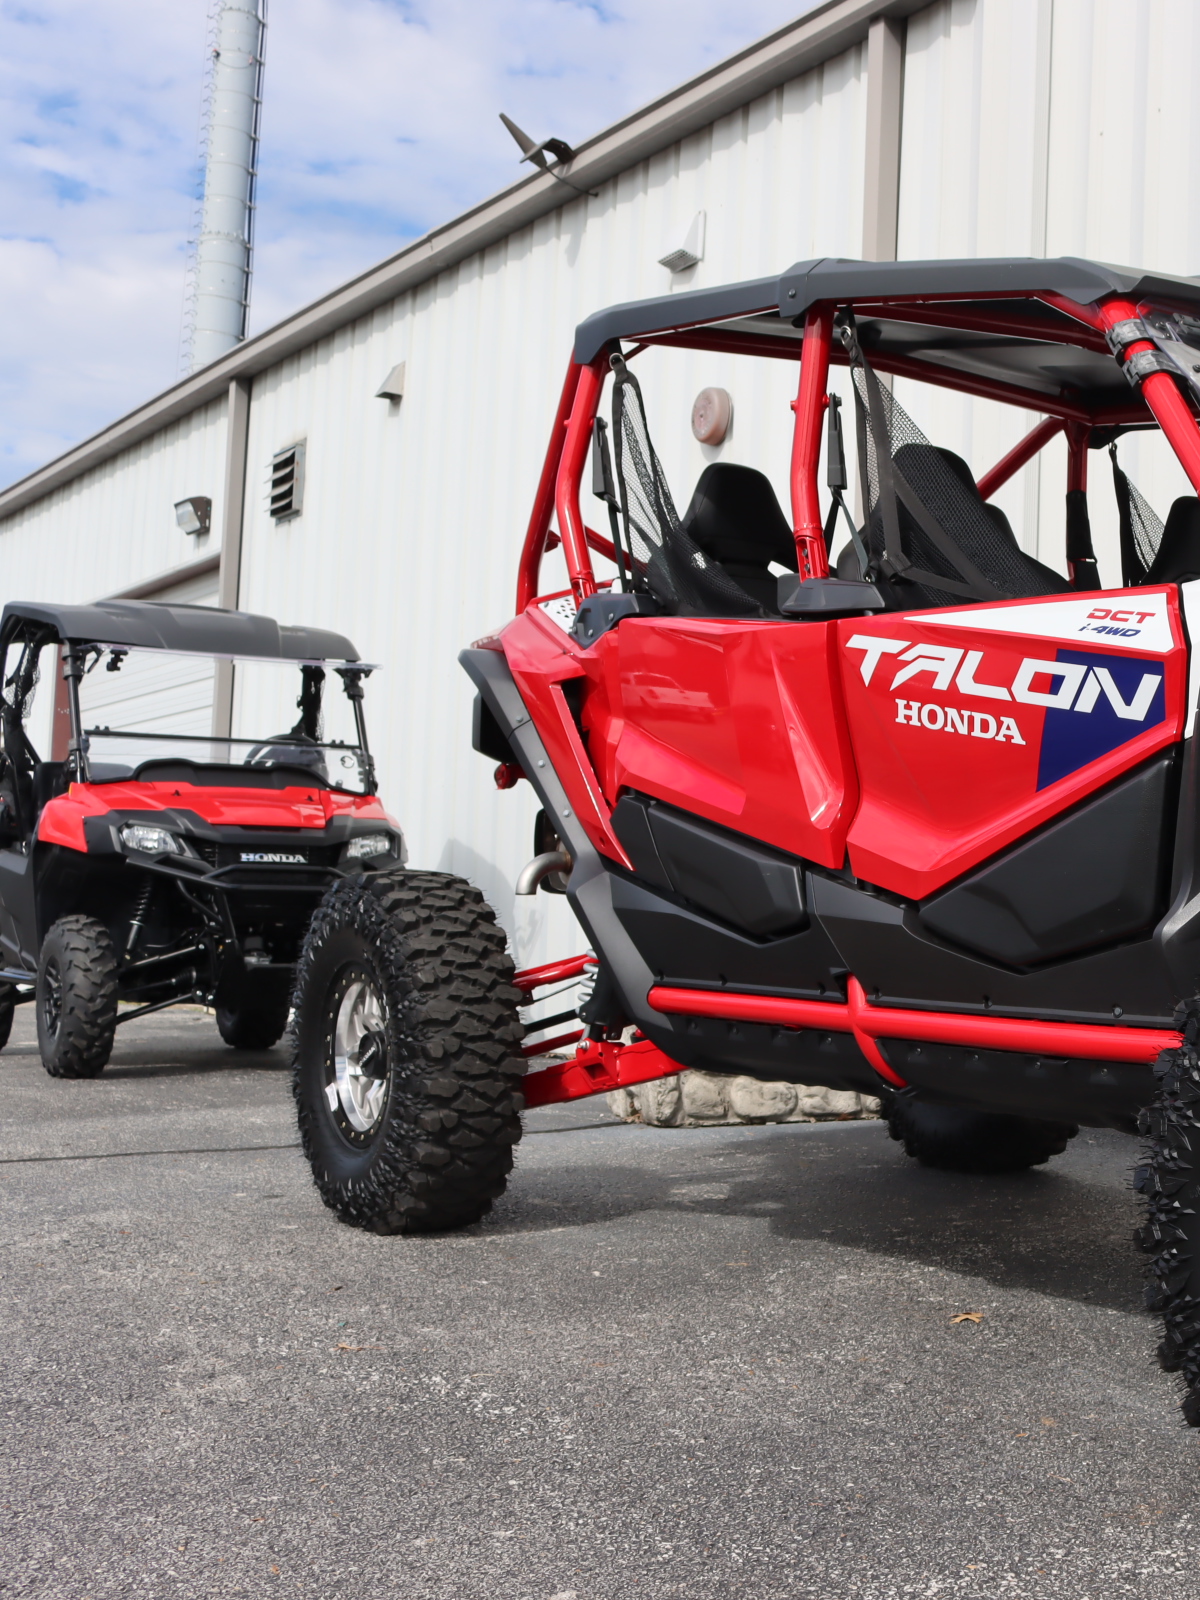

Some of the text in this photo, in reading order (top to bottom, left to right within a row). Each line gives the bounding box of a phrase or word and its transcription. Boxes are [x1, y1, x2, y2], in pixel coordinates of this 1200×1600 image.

[1086, 608, 1156, 624] DCT
[845, 634, 1162, 721] TALON
[895, 699, 1026, 745] HONDA
[240, 853, 308, 863] HONDA
